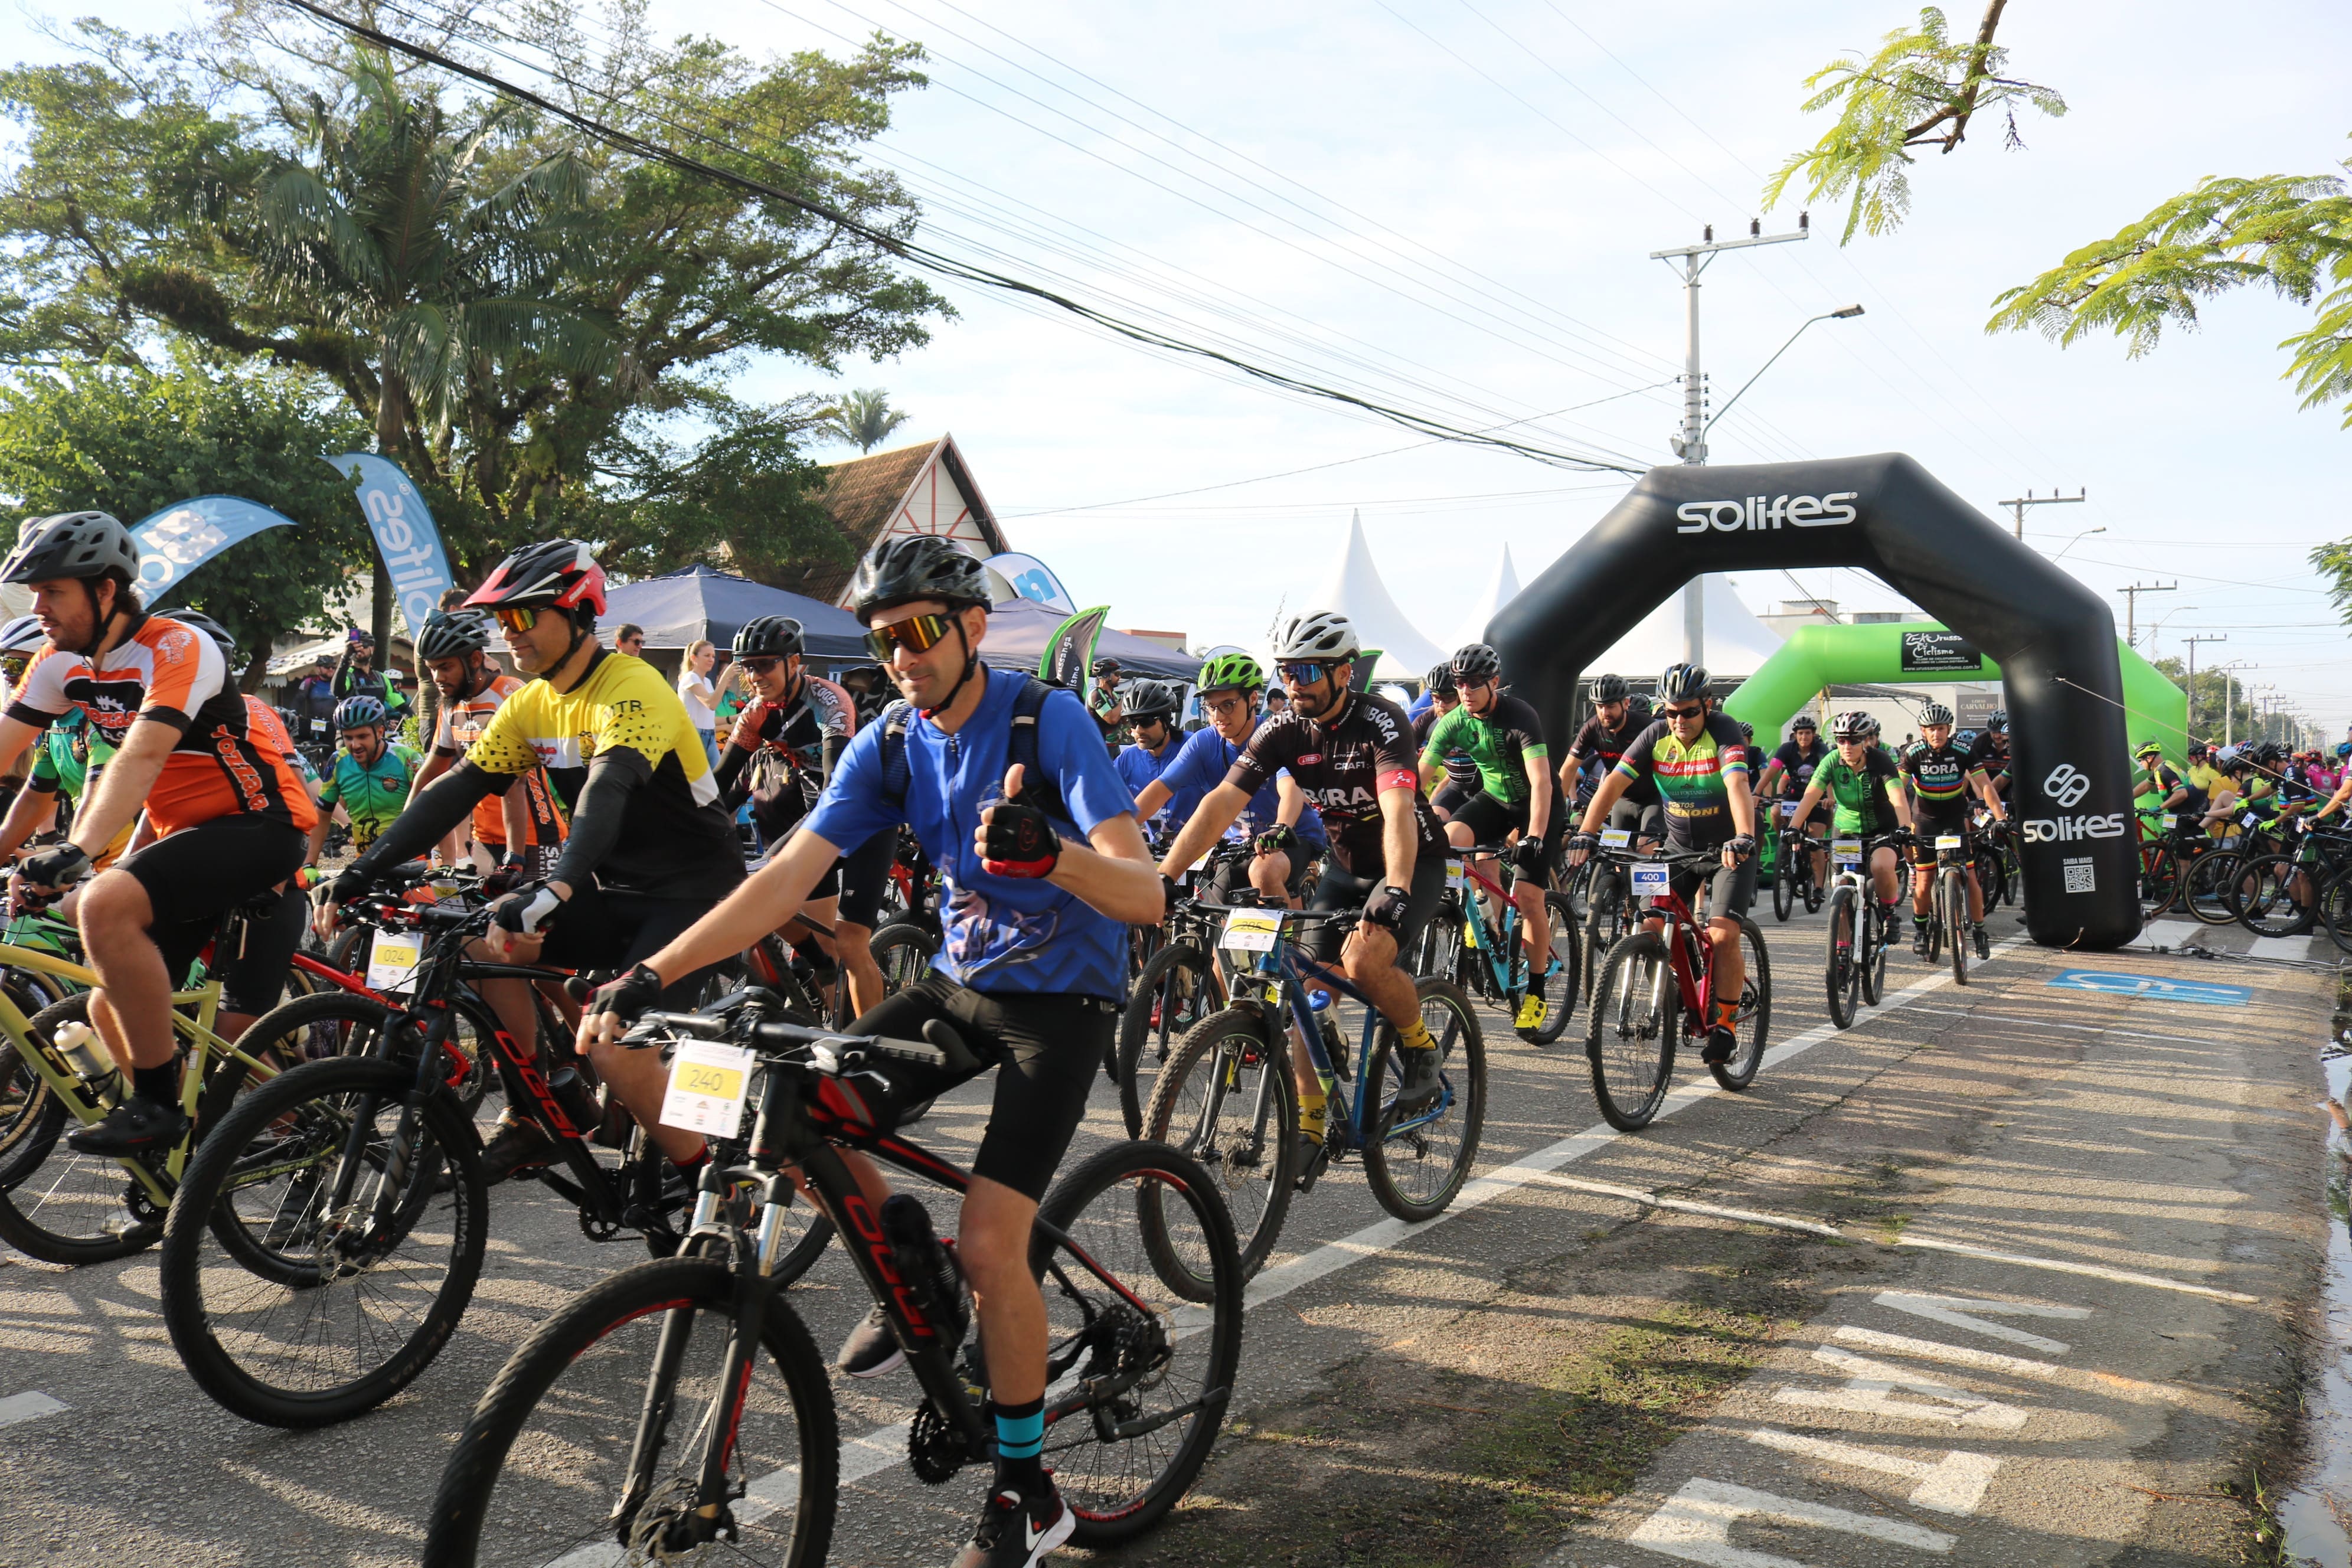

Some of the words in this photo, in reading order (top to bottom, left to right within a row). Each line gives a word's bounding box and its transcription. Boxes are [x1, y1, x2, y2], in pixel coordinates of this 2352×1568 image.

[1677, 492, 1857, 533] solifes
[1368, 707, 1399, 745] BORA
[1334, 761, 1366, 770] CRAFT
[1920, 763, 1959, 775] BORA
[1302, 786, 1374, 806] BORA
[2023, 813, 2125, 842] solifes
[1391, 901, 1406, 921] SKIN
[384, 949, 405, 963] 024
[495, 1030, 580, 1138] OGGI
[690, 1069, 724, 1092] 240
